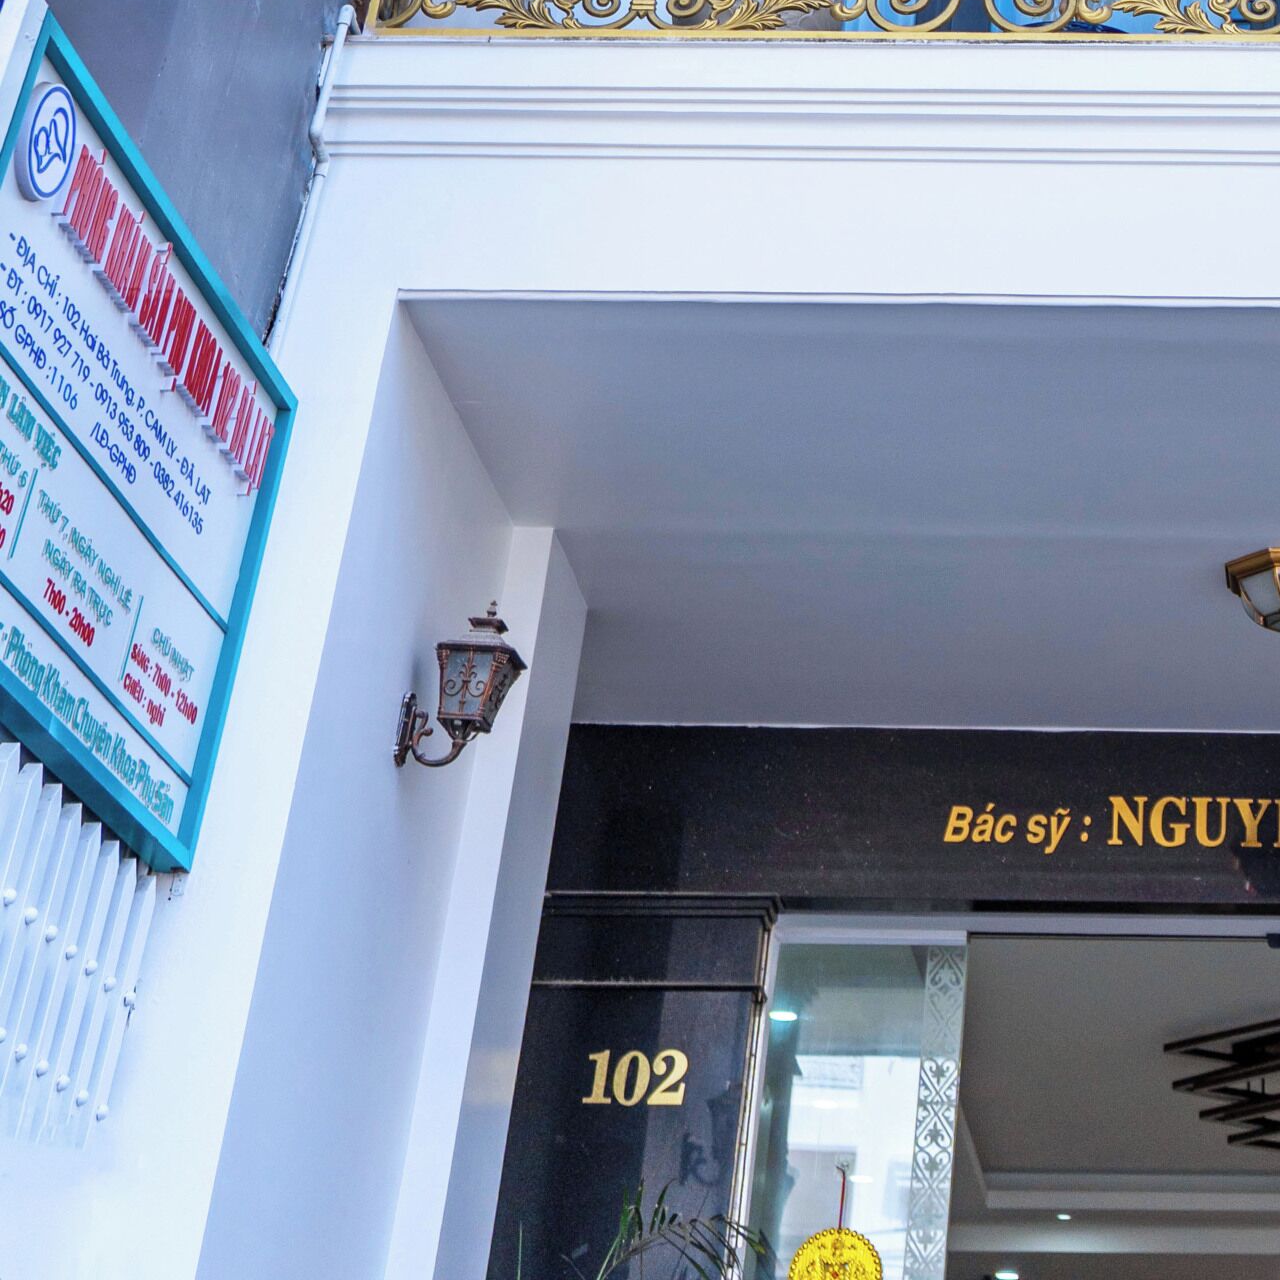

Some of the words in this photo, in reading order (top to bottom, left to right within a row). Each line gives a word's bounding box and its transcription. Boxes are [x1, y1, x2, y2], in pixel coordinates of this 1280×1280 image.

[15, 324, 47, 370] GPHĐ
[16, 236, 36, 274] ĐỊA
[37, 265, 60, 299] CHỈ
[63, 296, 81, 330] 102
[79, 319, 98, 352] Hai
[145, 410, 167, 448] CAM
[194, 477, 211, 506] LẠT
[103, 203, 152, 313] KHÁM
[139, 241, 176, 347] SẢN
[161, 288, 197, 392] PHỤ
[184, 319, 223, 417] KHOA
[212, 361, 241, 443] 102
[244, 407, 275, 496] LẠT
[7, 267, 24, 297] ĐT
[27, 295, 54, 333] 0917
[53, 327, 73, 358] 927
[71, 351, 90, 382] 719
[94, 382, 118, 420] 0913
[118, 412, 134, 441] 953
[133, 434, 151, 462] 809
[153, 461, 174, 498] 0382
[173, 489, 204, 535] 416135
[43, 577, 67, 615] 7h00
[69, 607, 96, 648] 20h00
[70, 570, 88, 600] RA
[152, 662, 172, 698] 7h00
[175, 687, 198, 726] 12h00
[109, 733, 137, 786] Khoa
[943, 802, 1018, 844] Bác
[1025, 808, 1071, 854] sỹ
[582, 1049, 690, 1107] 102
